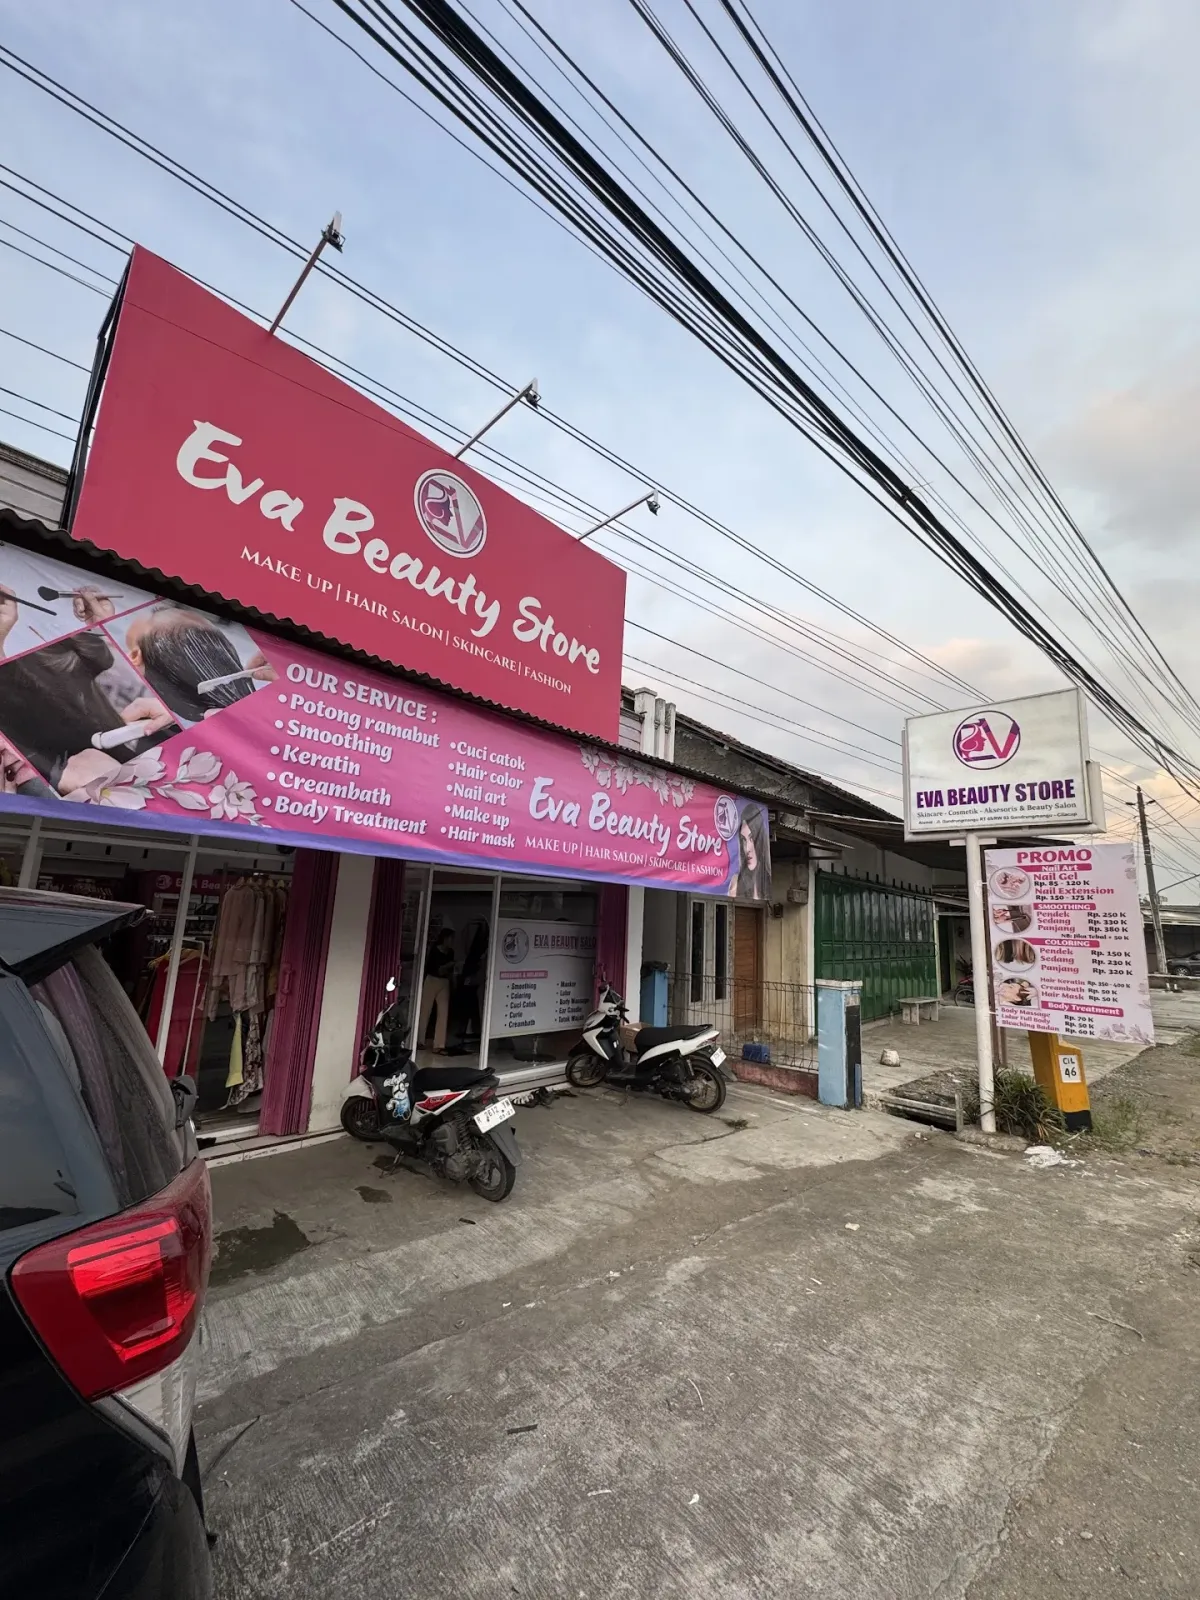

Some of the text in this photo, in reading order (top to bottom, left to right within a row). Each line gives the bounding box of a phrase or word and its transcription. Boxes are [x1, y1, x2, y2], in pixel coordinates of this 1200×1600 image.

[176, 420, 600, 674] Eva Beauty Store
[240, 546, 571, 695] MAKE UP HAIR SALON SKINCARE FASHION
[287, 664, 338, 694] OUR
[343, 680, 428, 721] SERVICE
[290, 694, 440, 748] Potong ramabut
[287, 720, 393, 762] Smoothing
[283, 745, 361, 776] Keratin
[457, 742, 525, 771] Cuci catok
[455, 762, 523, 789] Hair color
[279, 772, 391, 806] Creambath
[454, 782, 507, 806] Nail art
[917, 779, 1076, 808] EVA BEAUTY STORE
[274, 796, 428, 834] Body Treatment
[452, 805, 510, 831] Make up
[529, 776, 722, 856] Eva Beauty Store
[948, 808, 978, 816] Cosmetik
[984, 806, 1018, 814] Aksesoris
[448, 826, 516, 848] Hair mask
[525, 836, 724, 877] MAKE UP HAIR SALON SKINCARE FASHION
[1017, 849, 1092, 863] PROMO
[1034, 872, 1078, 881] Nail Gel
[1059, 887, 1114, 895] Extension
[1038, 925, 1075, 933] Panjang
[535, 935, 549, 948] EVA
[1041, 956, 1074, 964] Sedang
[1041, 965, 1079, 974] Panjang
[1041, 985, 1085, 993] Creambath
[1062, 992, 1084, 1000] Mask
[1001, 1007, 1018, 1015] Body
[1020, 1009, 1051, 1018] Massage
[1048, 1002, 1120, 1015] Body Treatment
[1002, 1020, 1035, 1029] Bleaching
[1034, 1016, 1051, 1024] Body
[1065, 1067, 1077, 1078] 46
